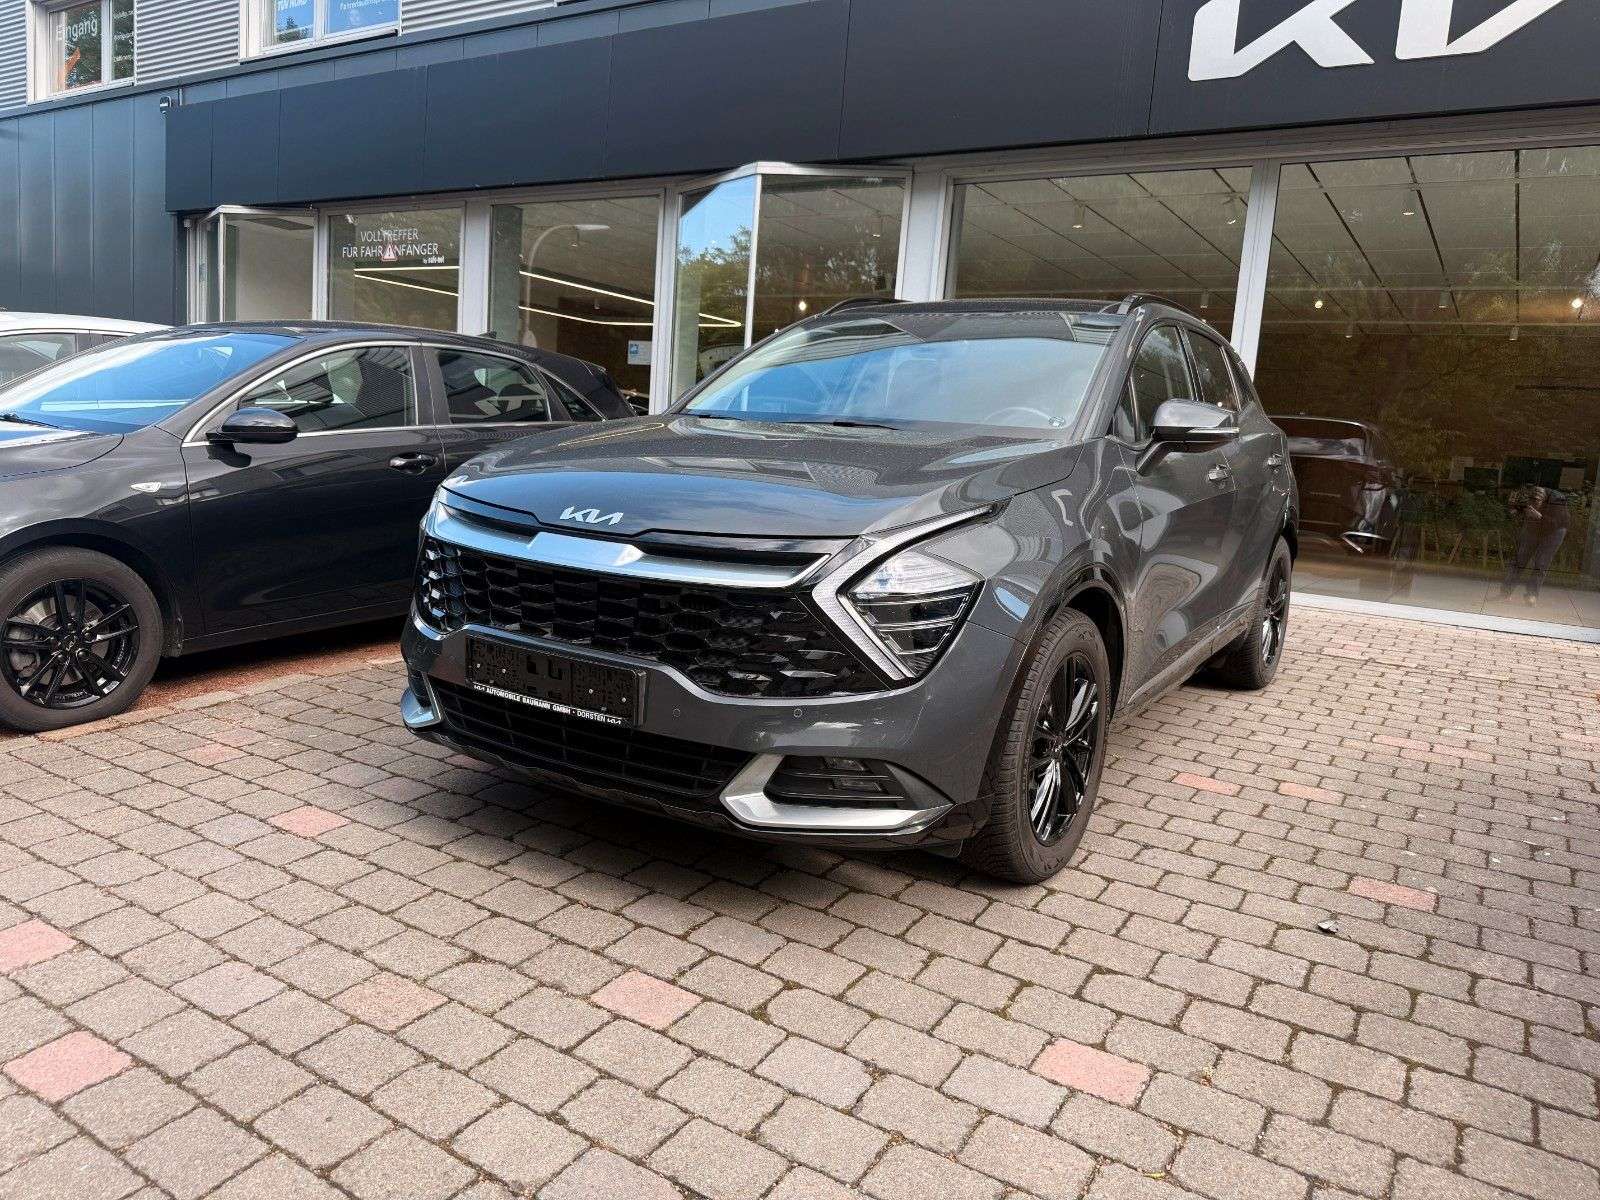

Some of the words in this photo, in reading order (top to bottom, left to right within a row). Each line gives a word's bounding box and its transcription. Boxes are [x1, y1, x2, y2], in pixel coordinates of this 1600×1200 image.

[360, 228, 419, 242] VOLLTREFFER
[342, 243, 358, 258] FÜR
[560, 506, 624, 525] KIA
[486, 687, 521, 702] AUTOMOBILE
[522, 697, 551, 710] BAUMANN
[577, 710, 606, 722] DORSTEN
